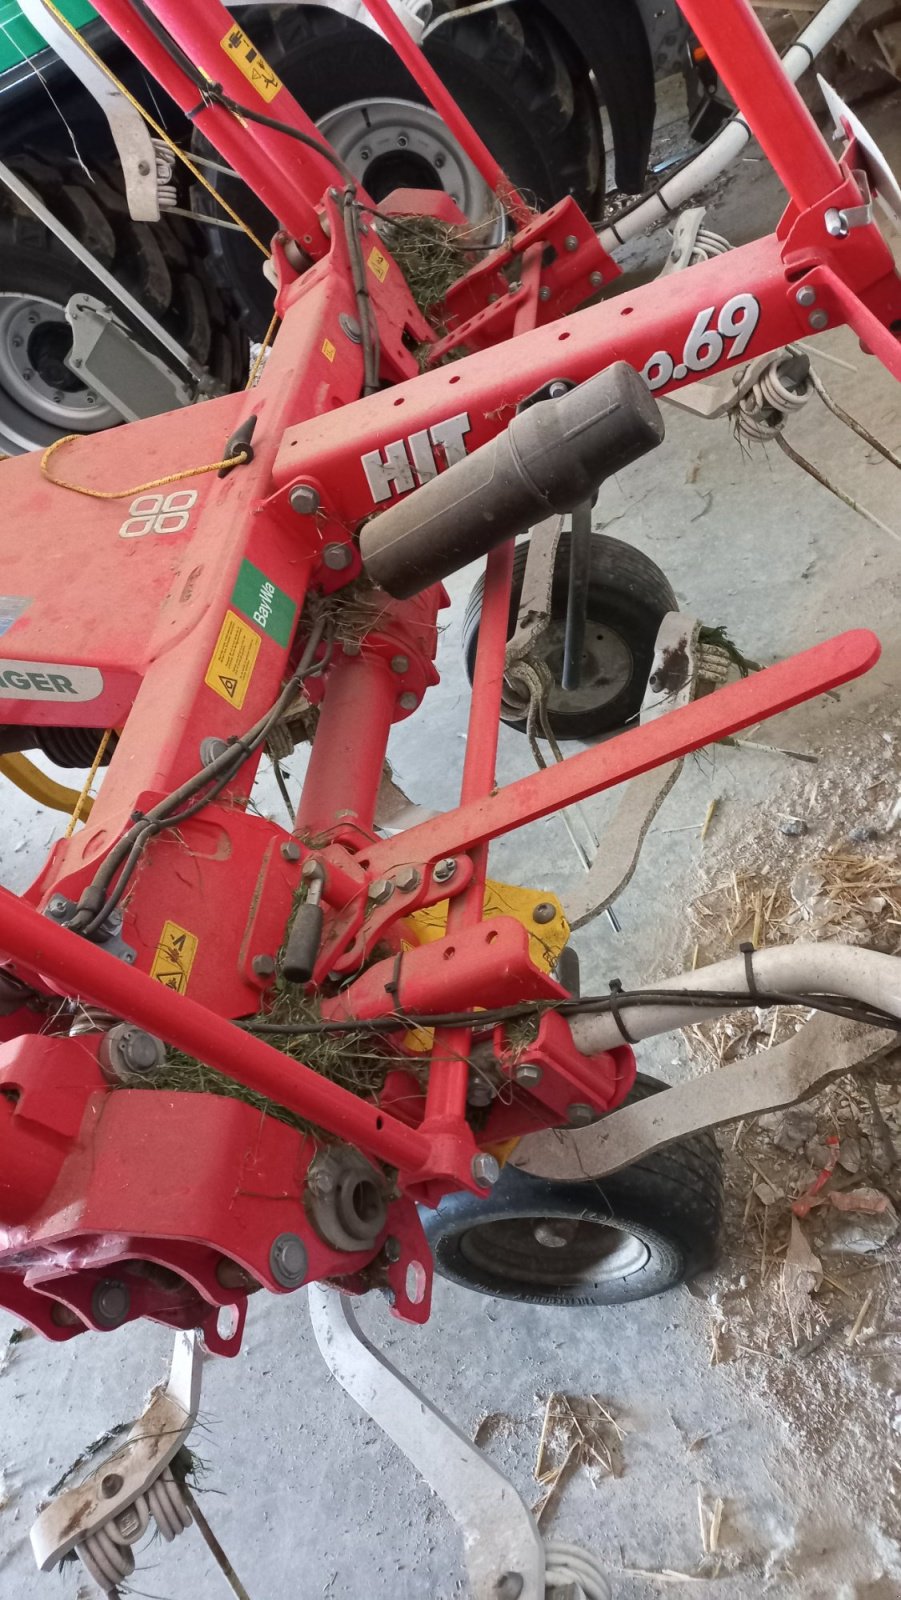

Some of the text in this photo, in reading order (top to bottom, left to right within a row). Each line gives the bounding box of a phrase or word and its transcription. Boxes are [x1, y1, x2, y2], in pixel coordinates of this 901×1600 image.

[361, 293, 760, 504] HIT o.69
[253, 581, 276, 628] BayWa
